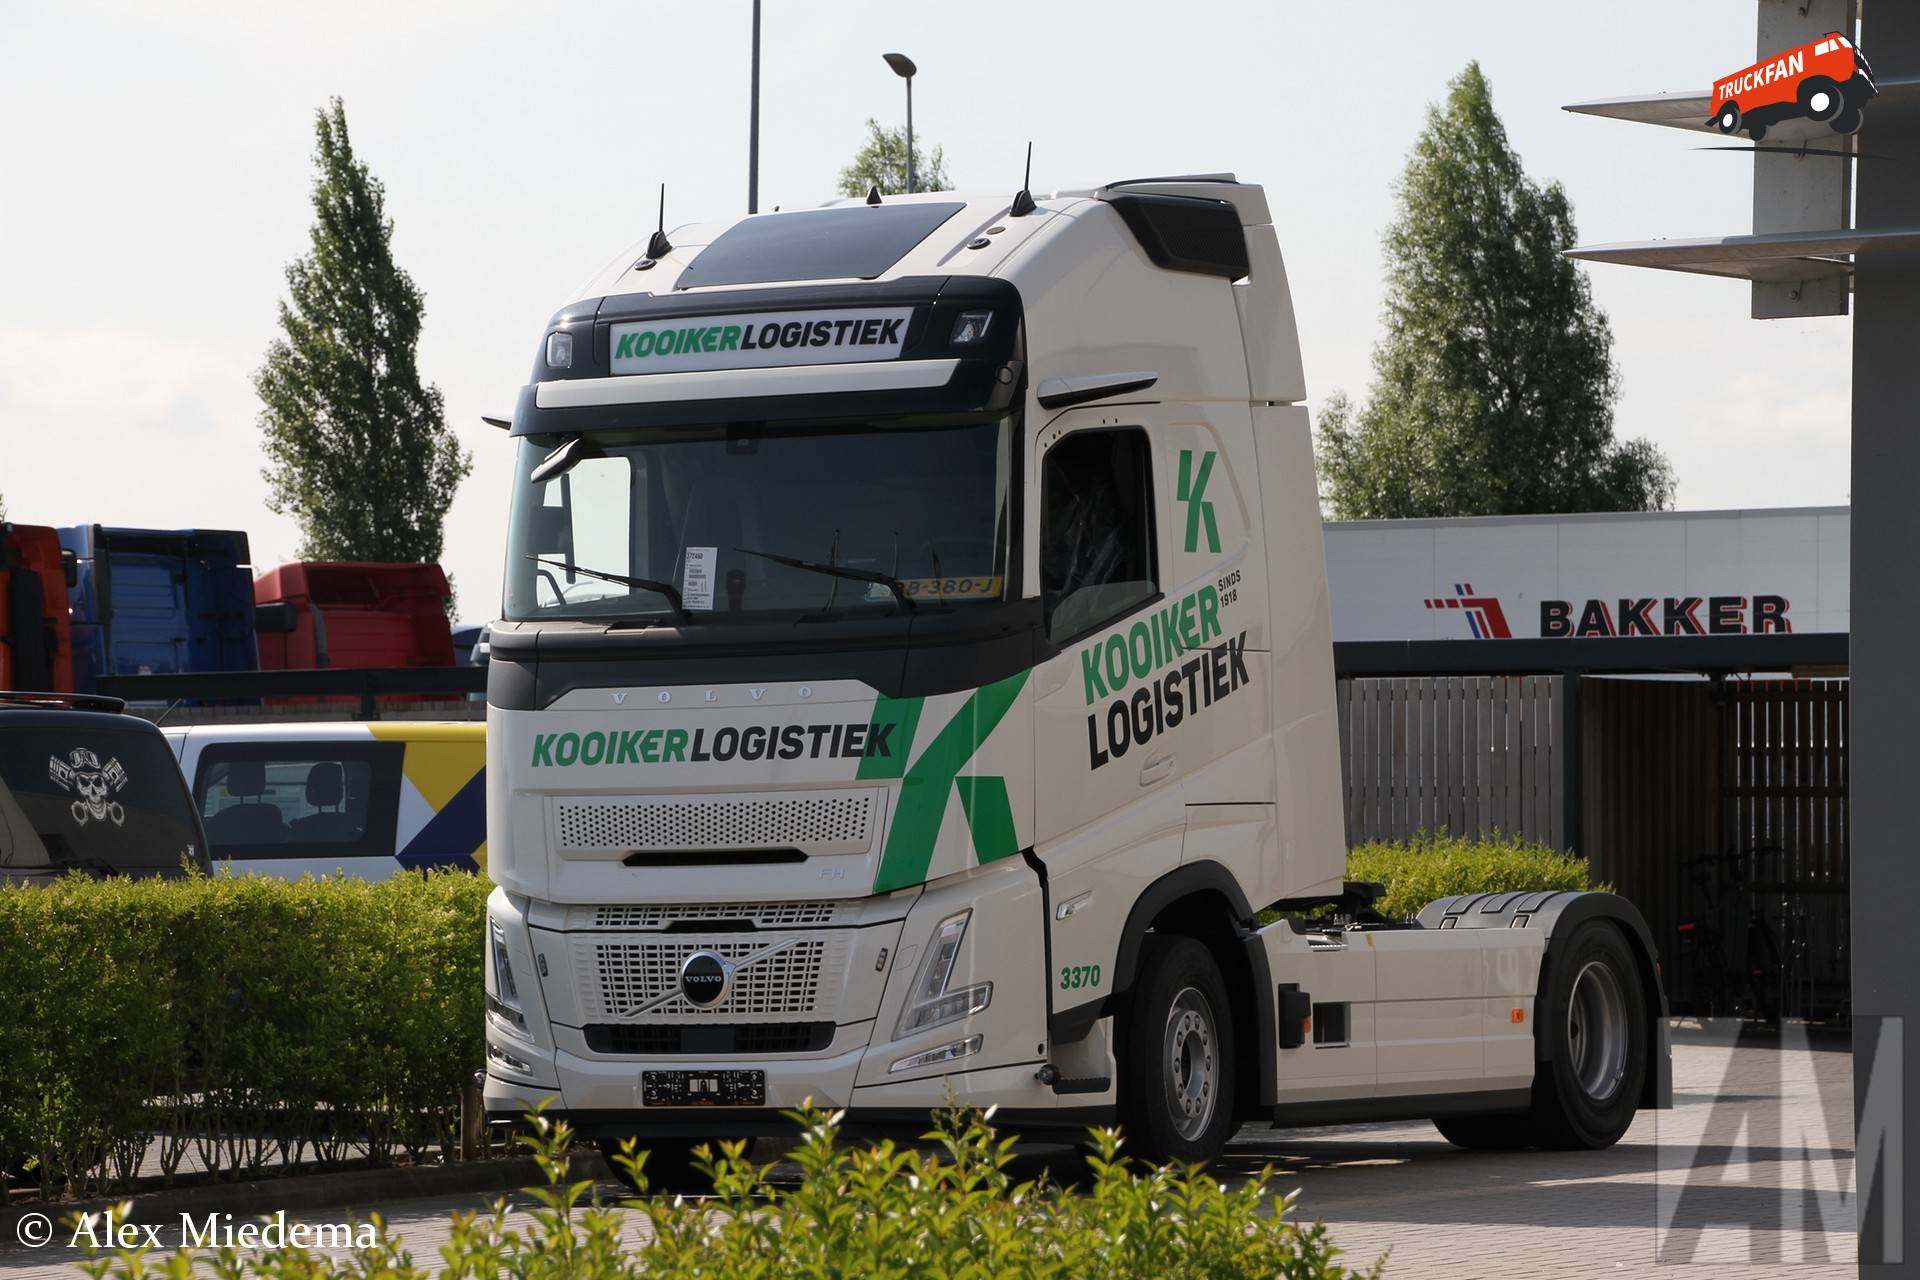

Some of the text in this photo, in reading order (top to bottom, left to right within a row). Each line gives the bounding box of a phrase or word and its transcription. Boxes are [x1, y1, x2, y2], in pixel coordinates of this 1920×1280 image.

[1217, 569, 1242, 593] SINDS
[1219, 588, 1239, 609] 1918
[1540, 594, 1793, 637] BAKKER
[1081, 584, 1222, 706] KOOIKER
[610, 686, 813, 704] VOLVO
[1087, 630, 1250, 771] LOGISTIEK
[685, 975, 722, 983] VOLVO
[1060, 964, 1101, 990] 3370
